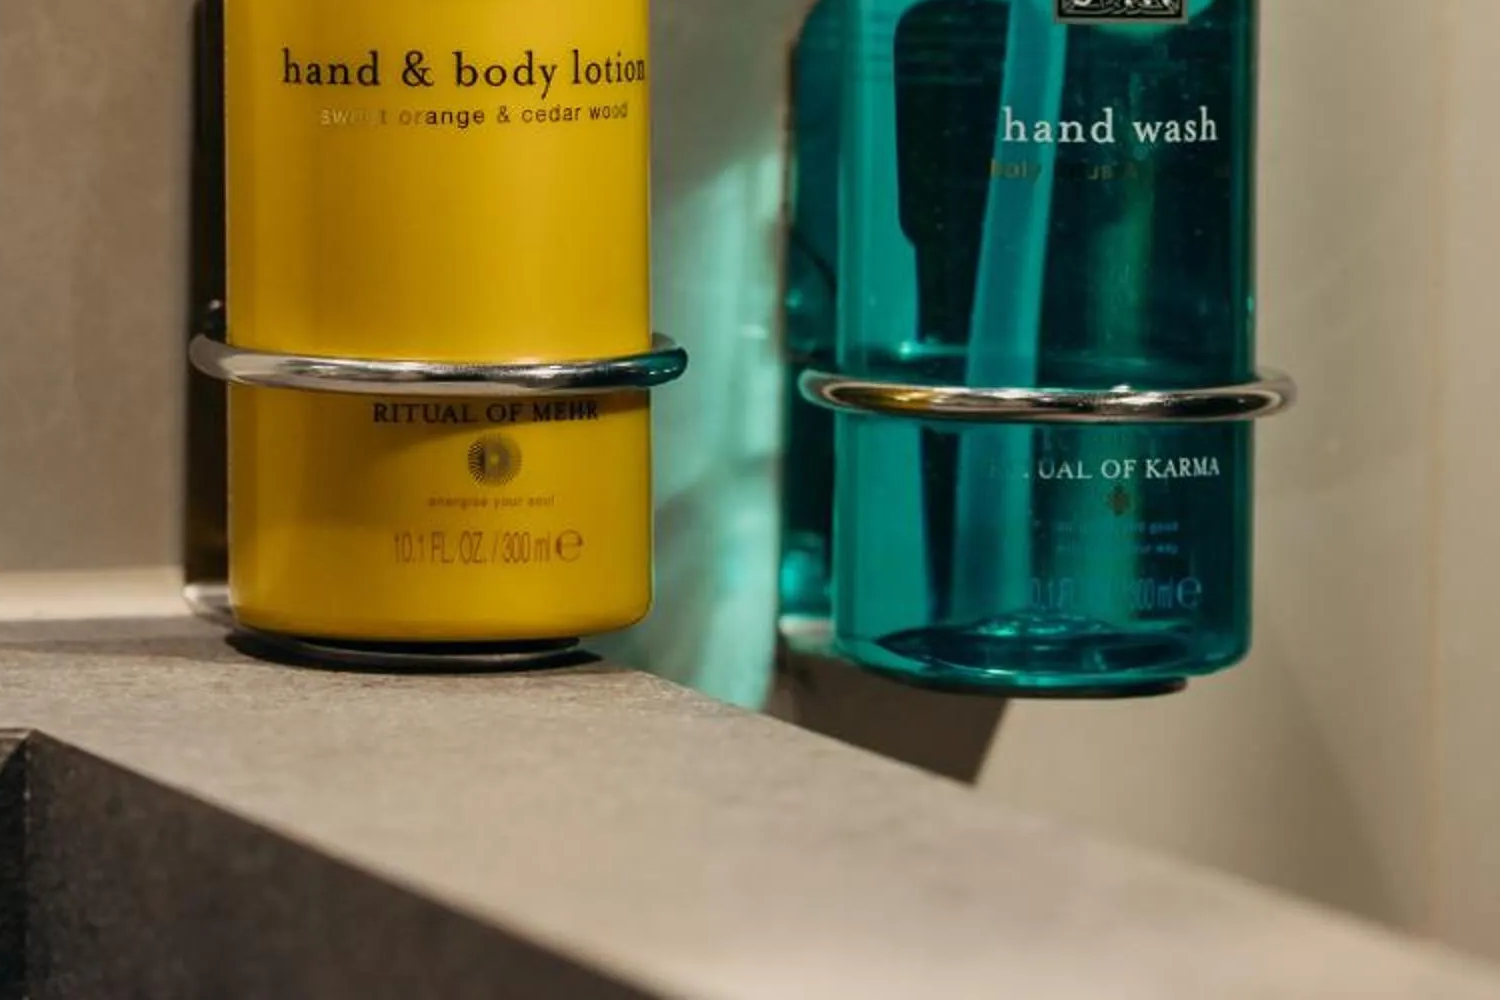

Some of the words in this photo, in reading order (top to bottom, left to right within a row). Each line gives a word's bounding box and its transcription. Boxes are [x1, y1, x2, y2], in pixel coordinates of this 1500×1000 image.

[282, 47, 381, 87] hand
[401, 49, 435, 88] &
[453, 50, 558, 100] body
[571, 48, 646, 85] lotion
[398, 107, 486, 129] orange
[497, 103, 511, 124] &
[521, 103, 581, 124] cedar
[589, 100, 629, 120] wood
[1002, 105, 1116, 143] hand
[1133, 105, 1220, 143] wash
[372, 402, 478, 424] RITUAL
[485, 402, 523, 424] OF
[531, 400, 599, 422] MEHR
[1100, 458, 1137, 479] OF
[1144, 456, 1221, 479] KARMA
[393, 530, 426, 565] 10.1
